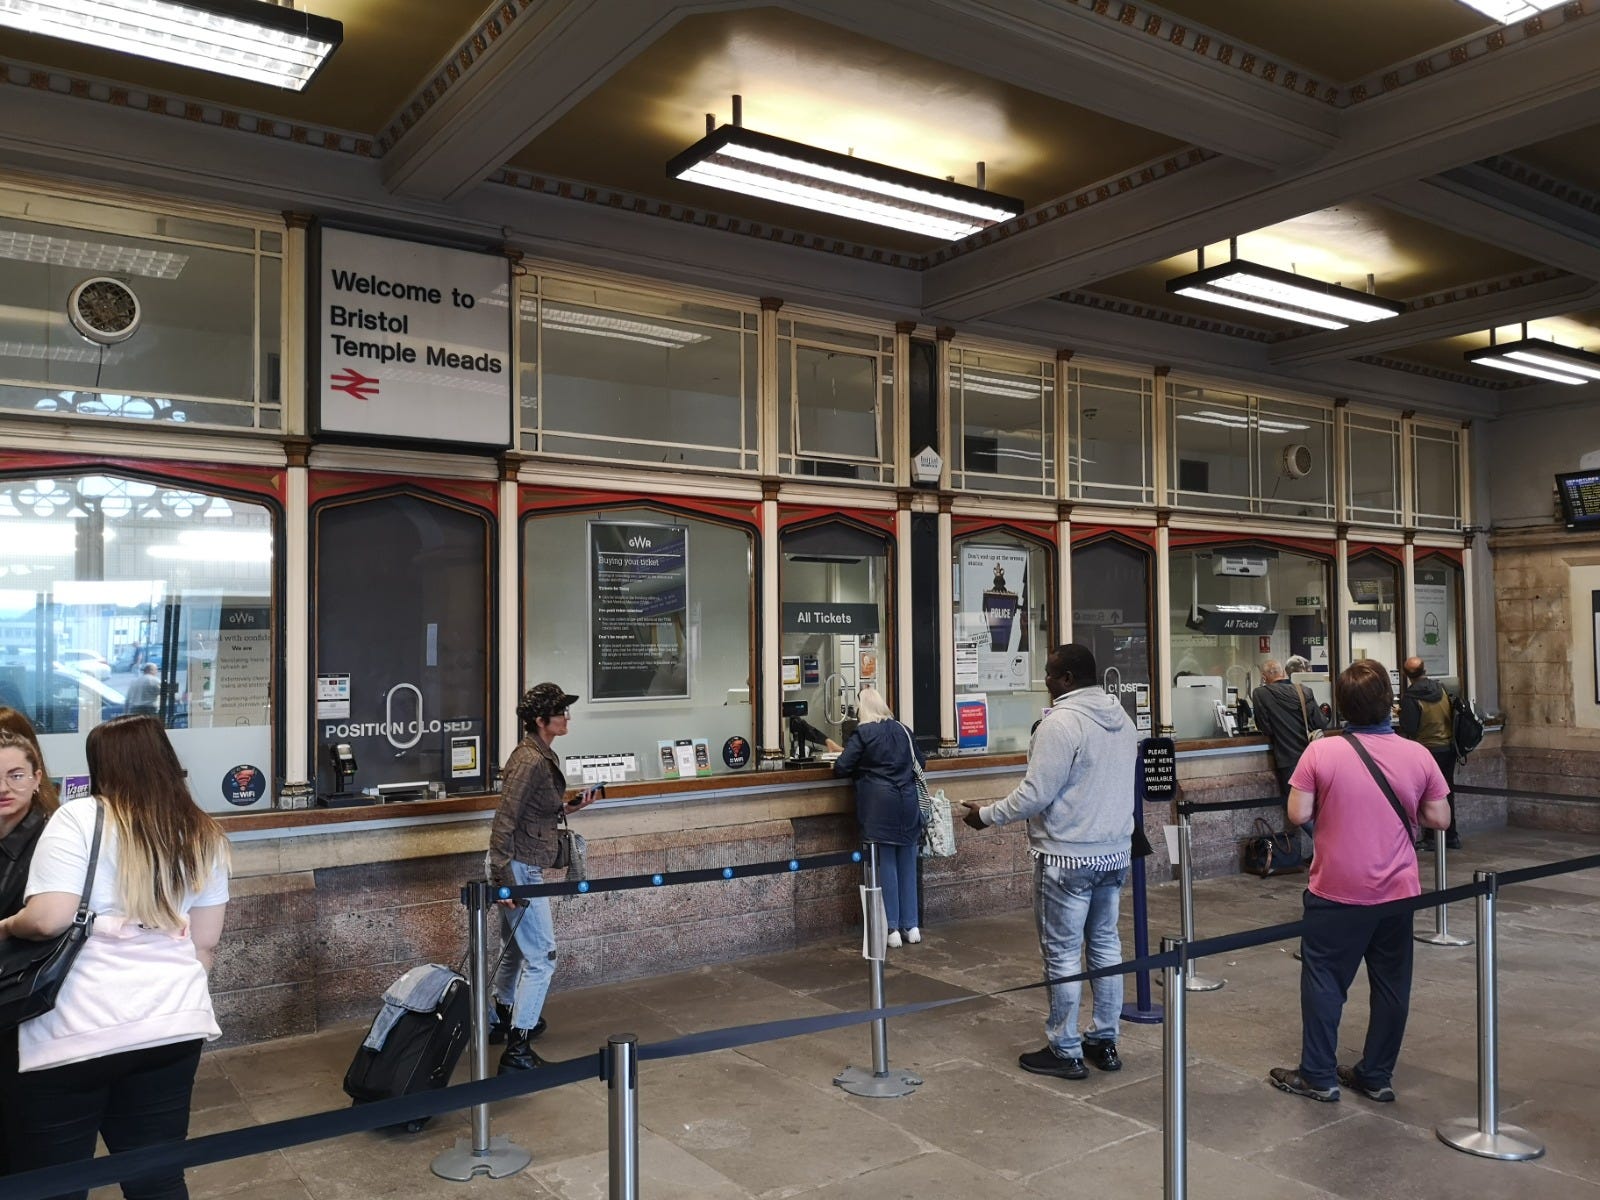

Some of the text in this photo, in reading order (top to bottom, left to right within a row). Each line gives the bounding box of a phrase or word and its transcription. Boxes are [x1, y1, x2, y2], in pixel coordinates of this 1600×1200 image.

[331, 269, 475, 309] Welcome to
[330, 305, 408, 334] Bristol
[331, 334, 502, 373] Temple Meads
[629, 536, 652, 549] GWR
[598, 556, 659, 567] Buying your ticket
[229, 612, 254, 624] GWR
[797, 612, 852, 623] All Tickets
[990, 608, 1011, 618] POLICE
[1224, 620, 1259, 629] All Tickets
[1358, 617, 1377, 626] Tickets
[1302, 636, 1321, 645] FIRE
[1109, 683, 1138, 693] CLOSE
[325, 720, 472, 738] POSITION CLOSED
